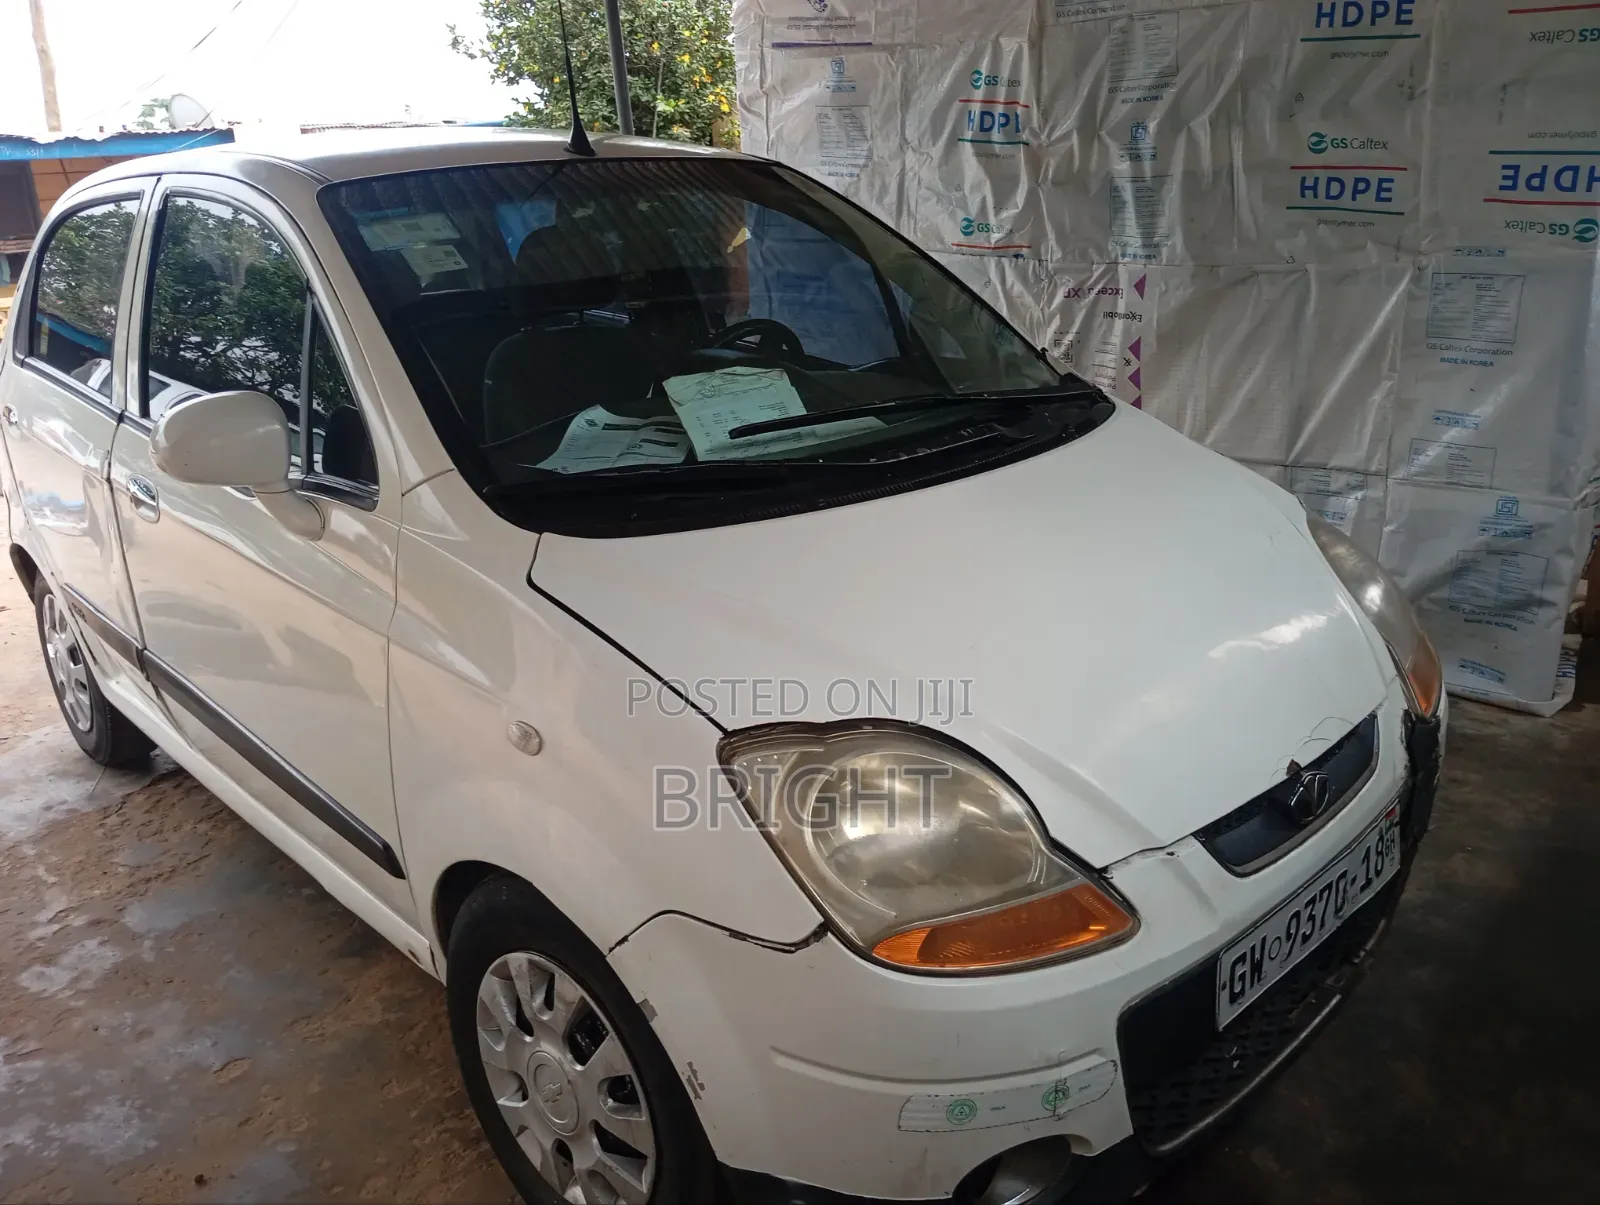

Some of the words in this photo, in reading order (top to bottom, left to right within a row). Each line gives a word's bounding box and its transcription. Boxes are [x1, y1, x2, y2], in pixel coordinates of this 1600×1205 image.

[1315, 0, 1415, 28] HDPE
[1529, 29, 1576, 44] Caltex
[1578, 28, 1600, 42] GS
[984, 75, 999, 86] GS
[1330, 138, 1348, 149] GS
[1350, 138, 1388, 150] Caltex
[1499, 164, 1600, 192] HDPE
[1300, 176, 1395, 202] HDPE
[977, 222, 991, 233] GS
[1504, 220, 1546, 234] Caltex
[1548, 223, 1570, 236] GS
[1464, 346, 1513, 356] Corporation
[1229, 934, 1267, 1005] GW
